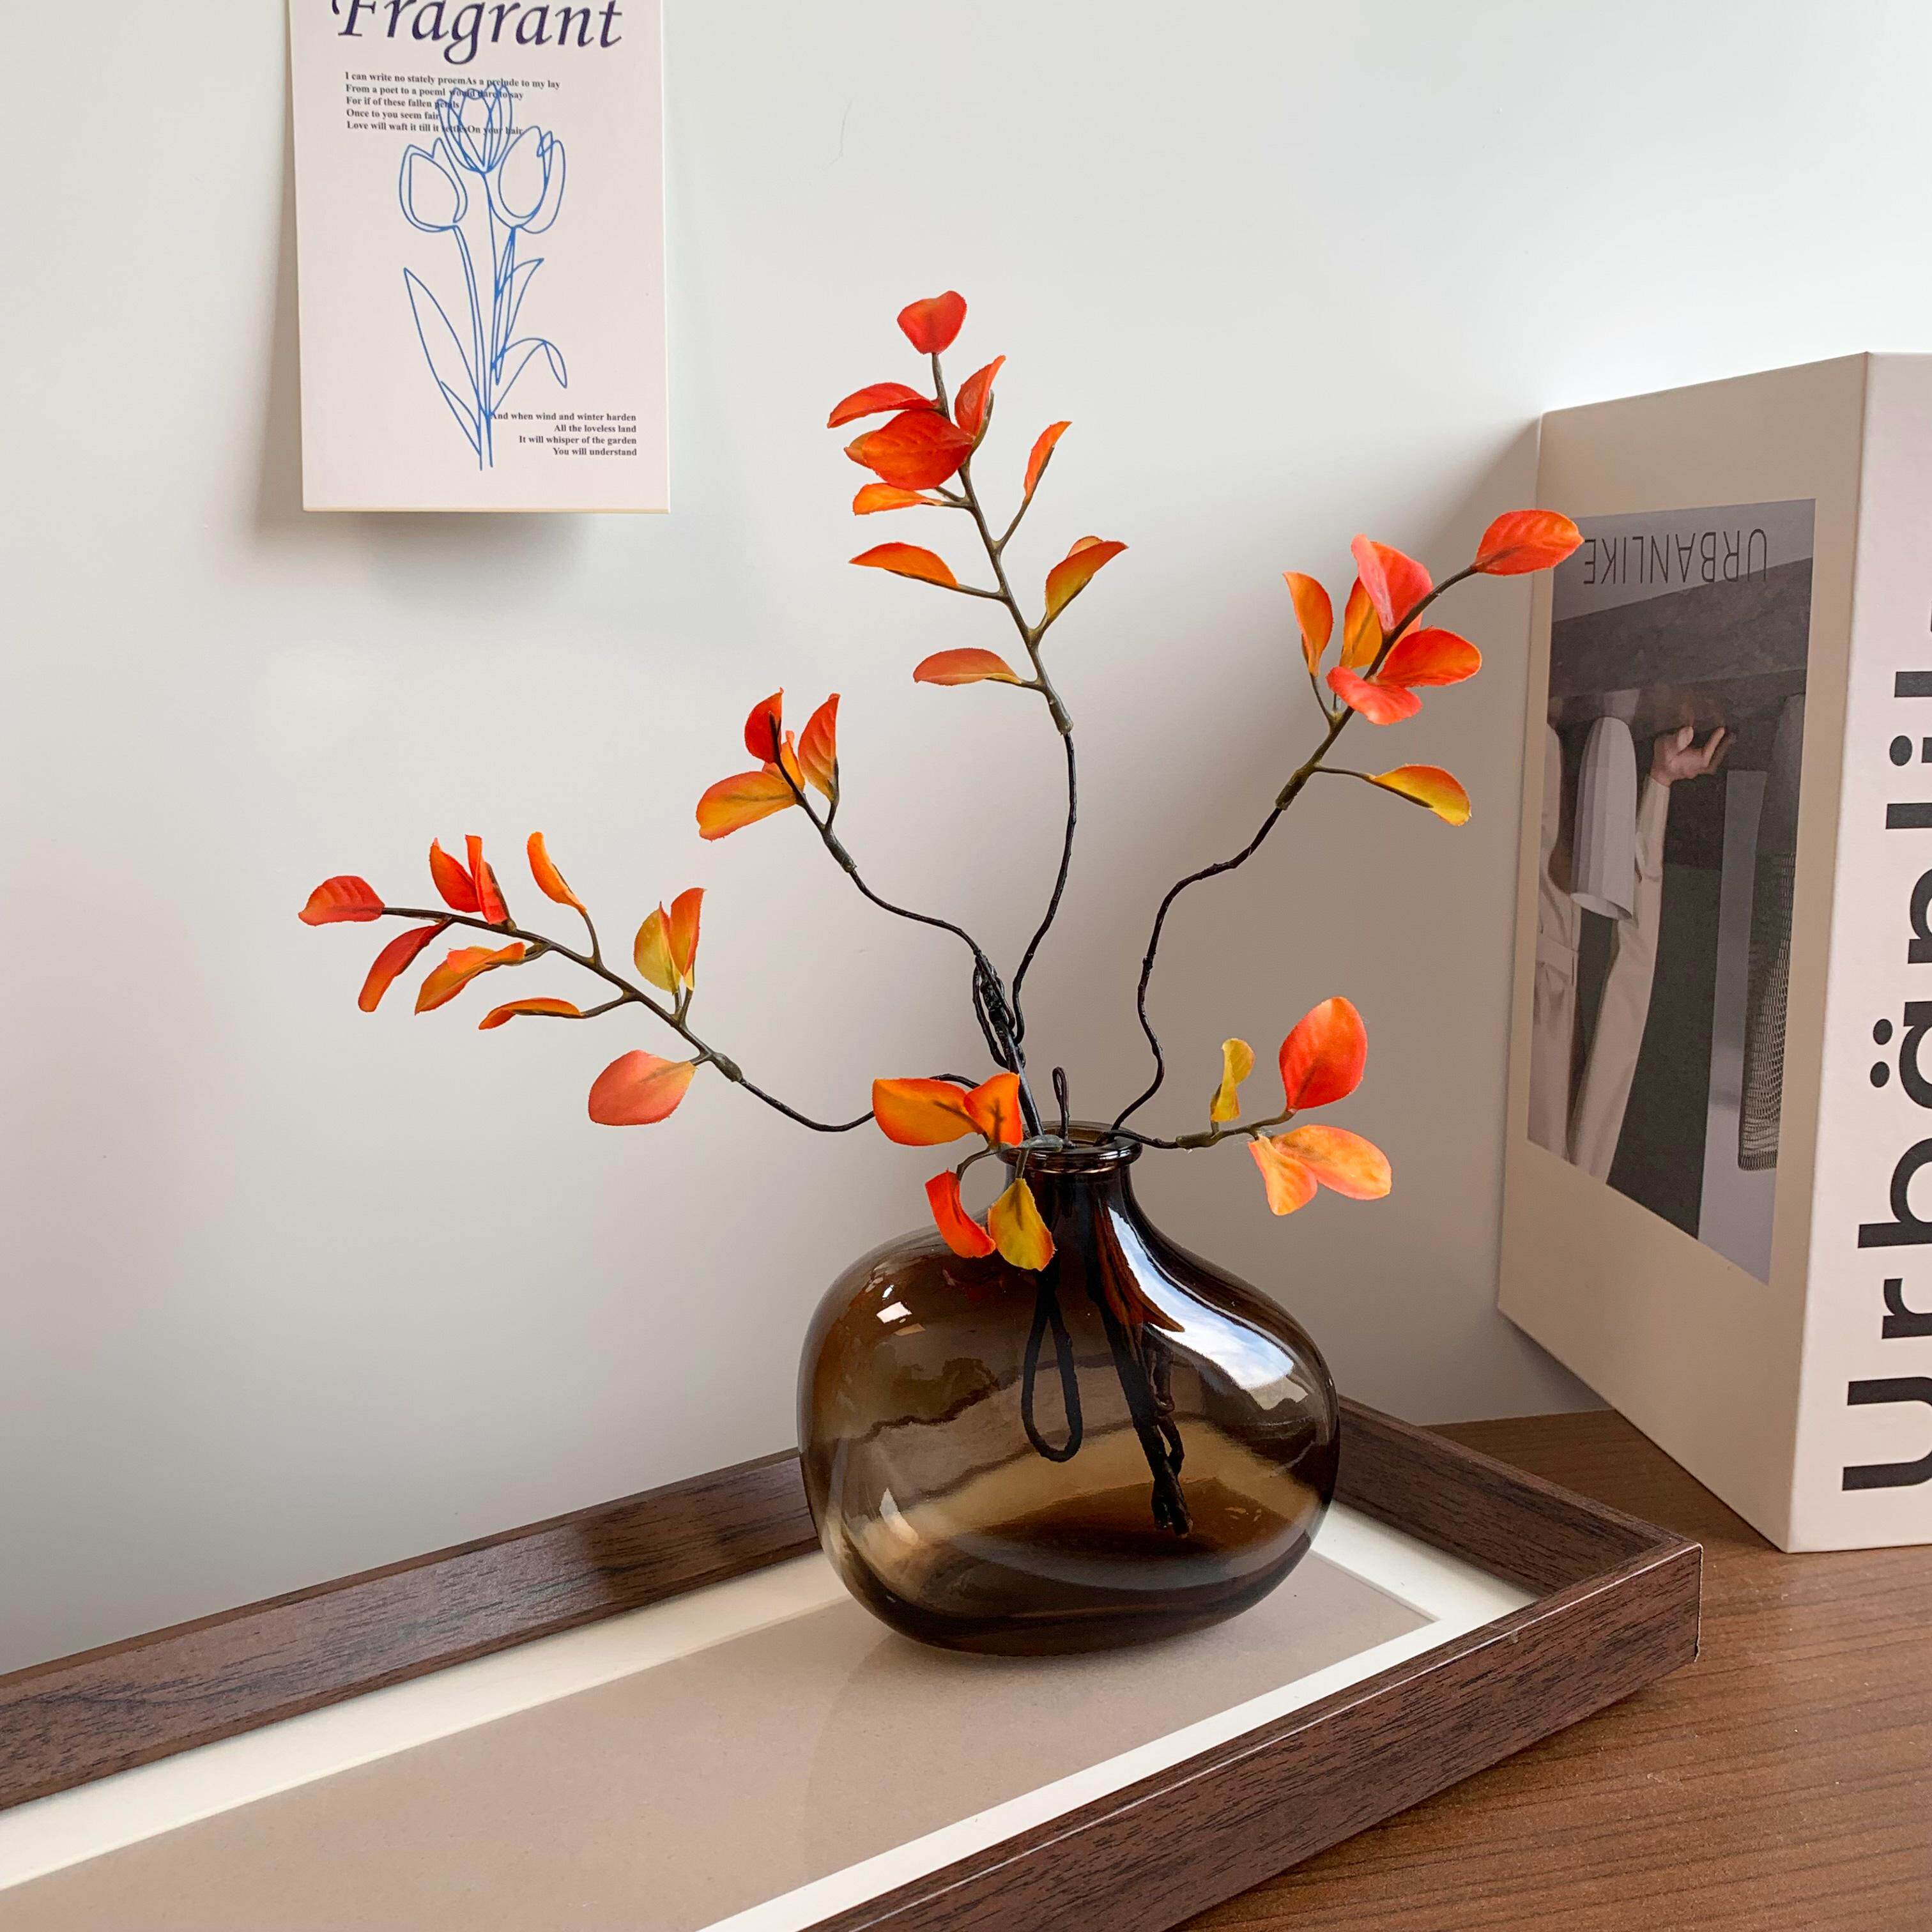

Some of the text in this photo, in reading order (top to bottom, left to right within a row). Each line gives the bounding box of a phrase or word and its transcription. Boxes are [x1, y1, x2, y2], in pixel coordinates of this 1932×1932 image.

[332, 0, 623, 65] Fragrant
[346, 72, 349, 80] I
[369, 73, 392, 82] write
[408, 75, 434, 85] stately
[487, 78, 519, 89] prelude
[532, 81, 544, 89] my
[548, 80, 560, 88] lay
[346, 84, 370, 93] From
[379, 86, 398, 95] poet
[449, 88, 475, 97] wod
[509, 92, 523, 101] say
[346, 96, 362, 105] For
[364, 96, 371, 105] if
[373, 97, 383, 105] of
[384, 98, 406, 107] these
[408, 99, 432, 108] fallen
[347, 109, 369, 118] Once
[347, 121, 368, 130] Love
[371, 121, 386, 130] will
[389, 123, 408, 131] waft
[410, 123, 417, 131] it
[419, 123, 431, 132] till
[484, 126, 503, 136] your
[536, 412, 556, 420] wind
[577, 413, 603, 421] winter
[546, 436, 579, 445] whisper
[607, 437, 637, 446] garden
[553, 447, 569, 456] You
[1583, 528, 1768, 585] URBANLIKE
